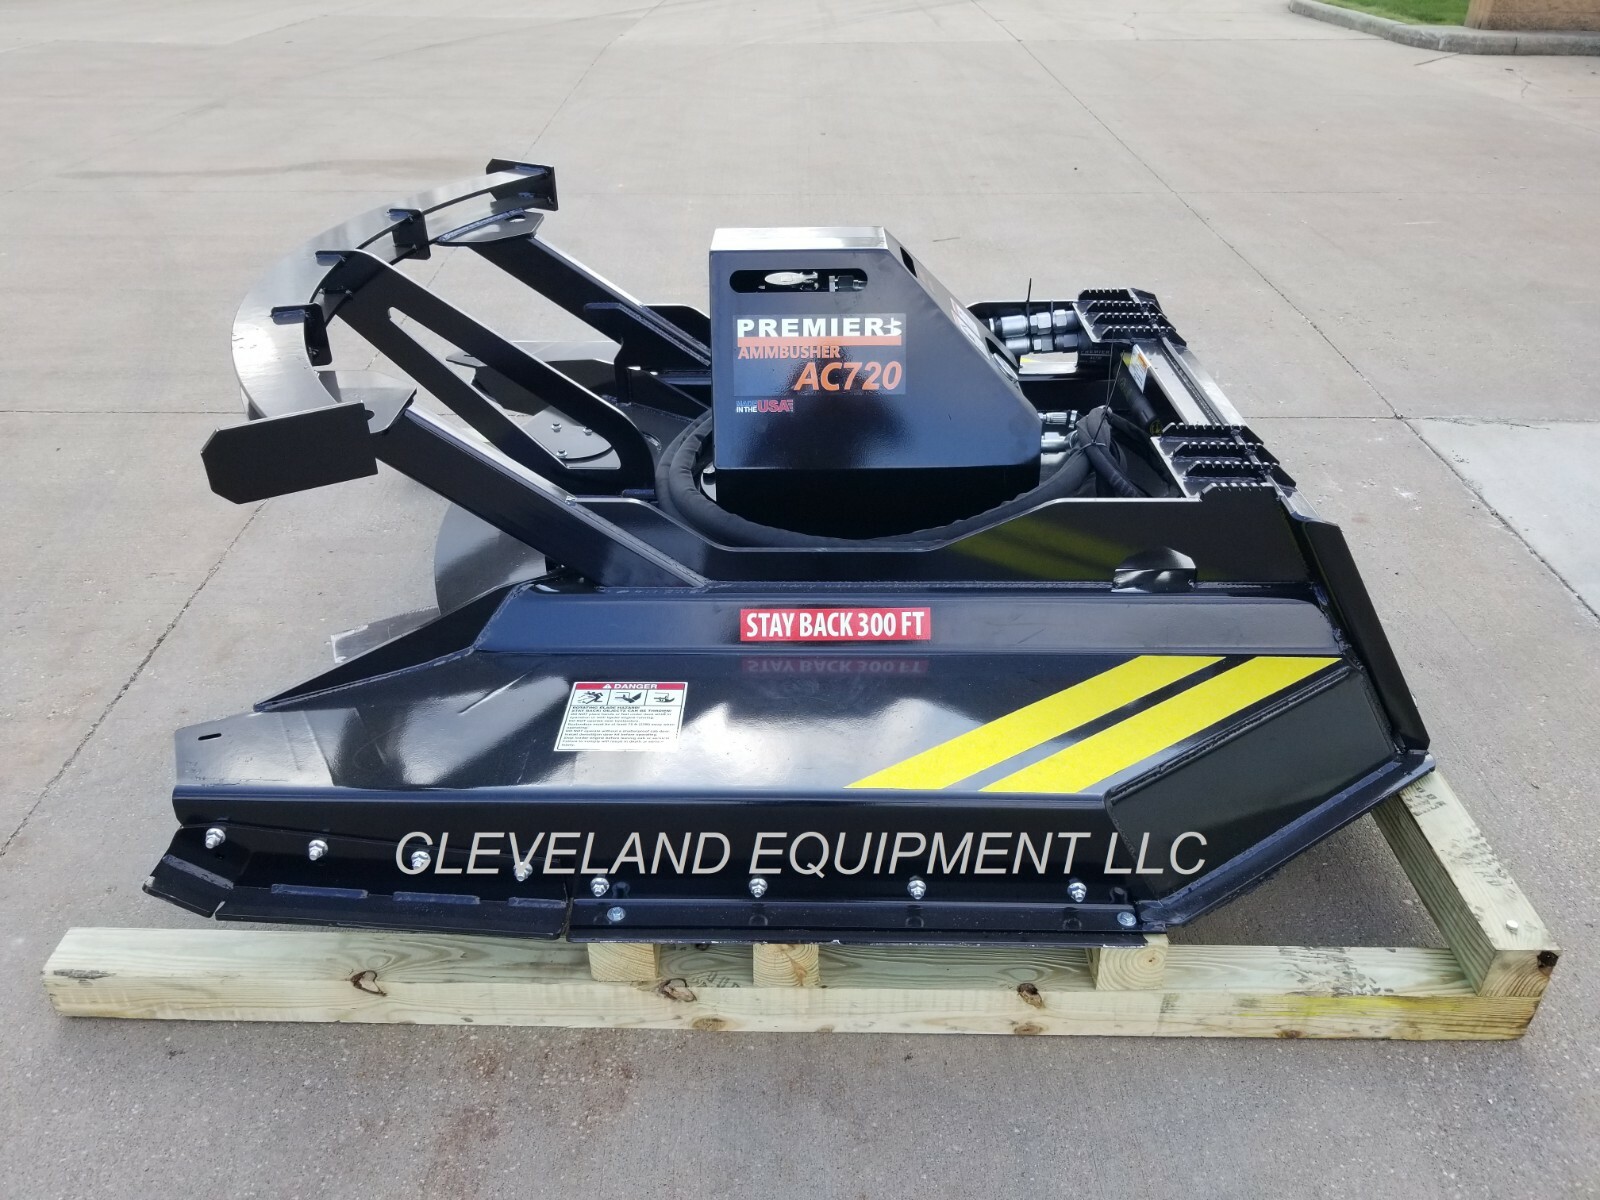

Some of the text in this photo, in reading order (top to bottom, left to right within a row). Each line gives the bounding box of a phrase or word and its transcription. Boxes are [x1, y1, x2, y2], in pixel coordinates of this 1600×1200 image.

[736, 317, 885, 338] PREMIER
[737, 345, 841, 360] AMMBUSHER
[793, 360, 903, 391] AC720
[757, 399, 789, 413] USA
[746, 611, 925, 638] STAY BACK 300 FT
